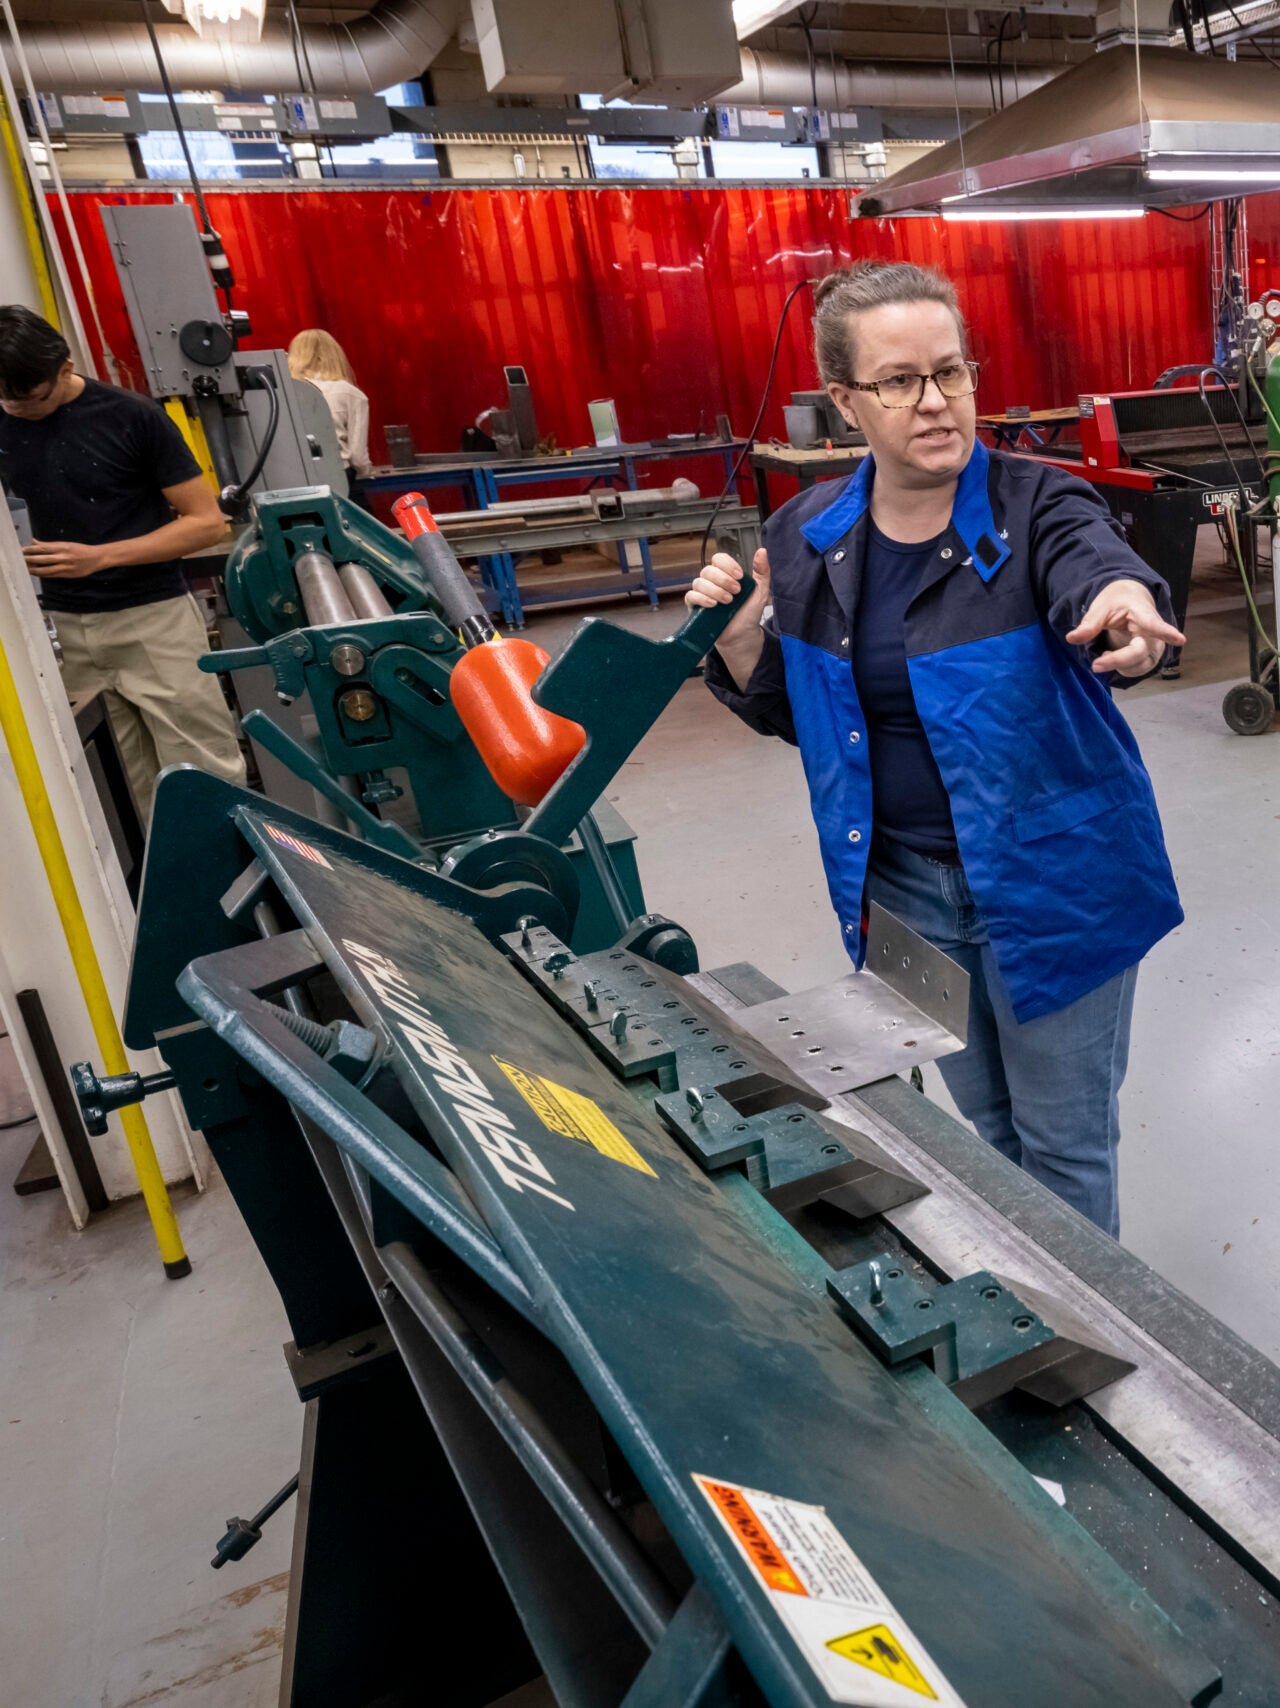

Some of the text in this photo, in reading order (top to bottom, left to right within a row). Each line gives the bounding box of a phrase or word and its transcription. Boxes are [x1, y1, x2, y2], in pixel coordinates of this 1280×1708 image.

[342, 939, 576, 1212] TENNSMITH
[509, 1067, 567, 1134] CAUTION
[713, 1486, 782, 1568] WARNING
